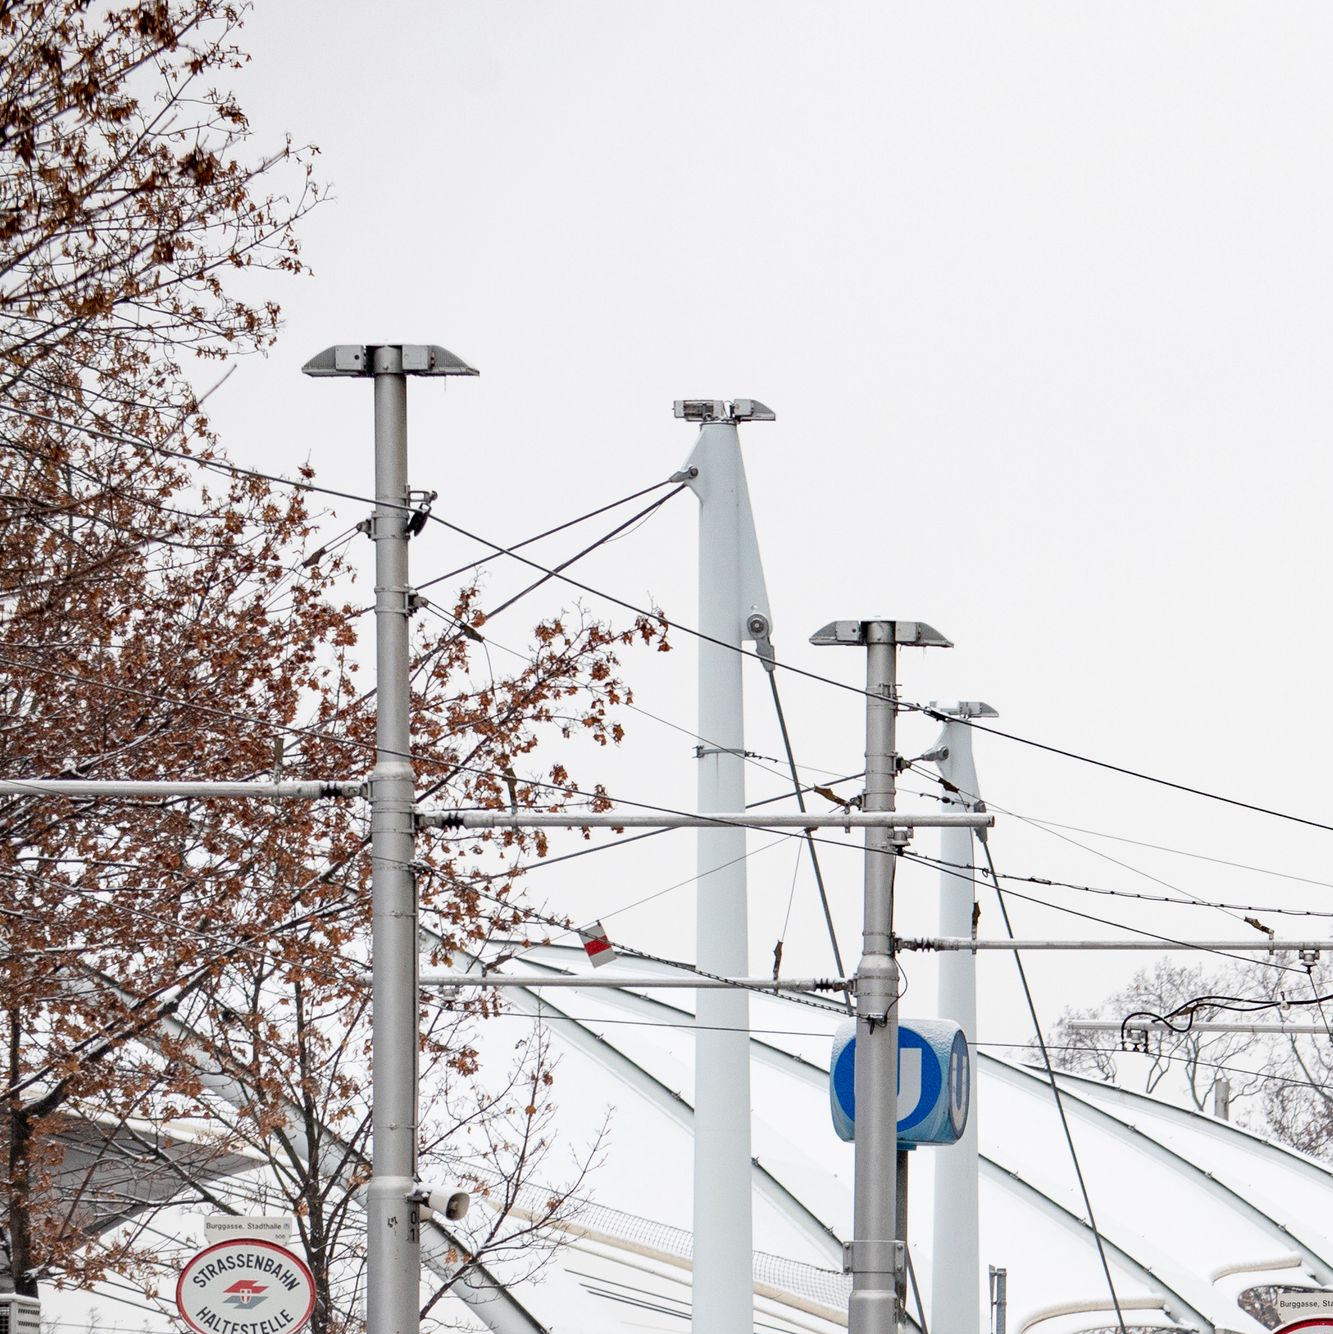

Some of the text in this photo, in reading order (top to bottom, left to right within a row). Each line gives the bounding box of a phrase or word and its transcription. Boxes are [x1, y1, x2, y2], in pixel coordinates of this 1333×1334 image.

[206, 1222, 282, 1231] Burggasse, Stadthalle
[193, 1254, 301, 1292] STRASSENBAHN
[1279, 1300, 1320, 1309] Burggasse,
